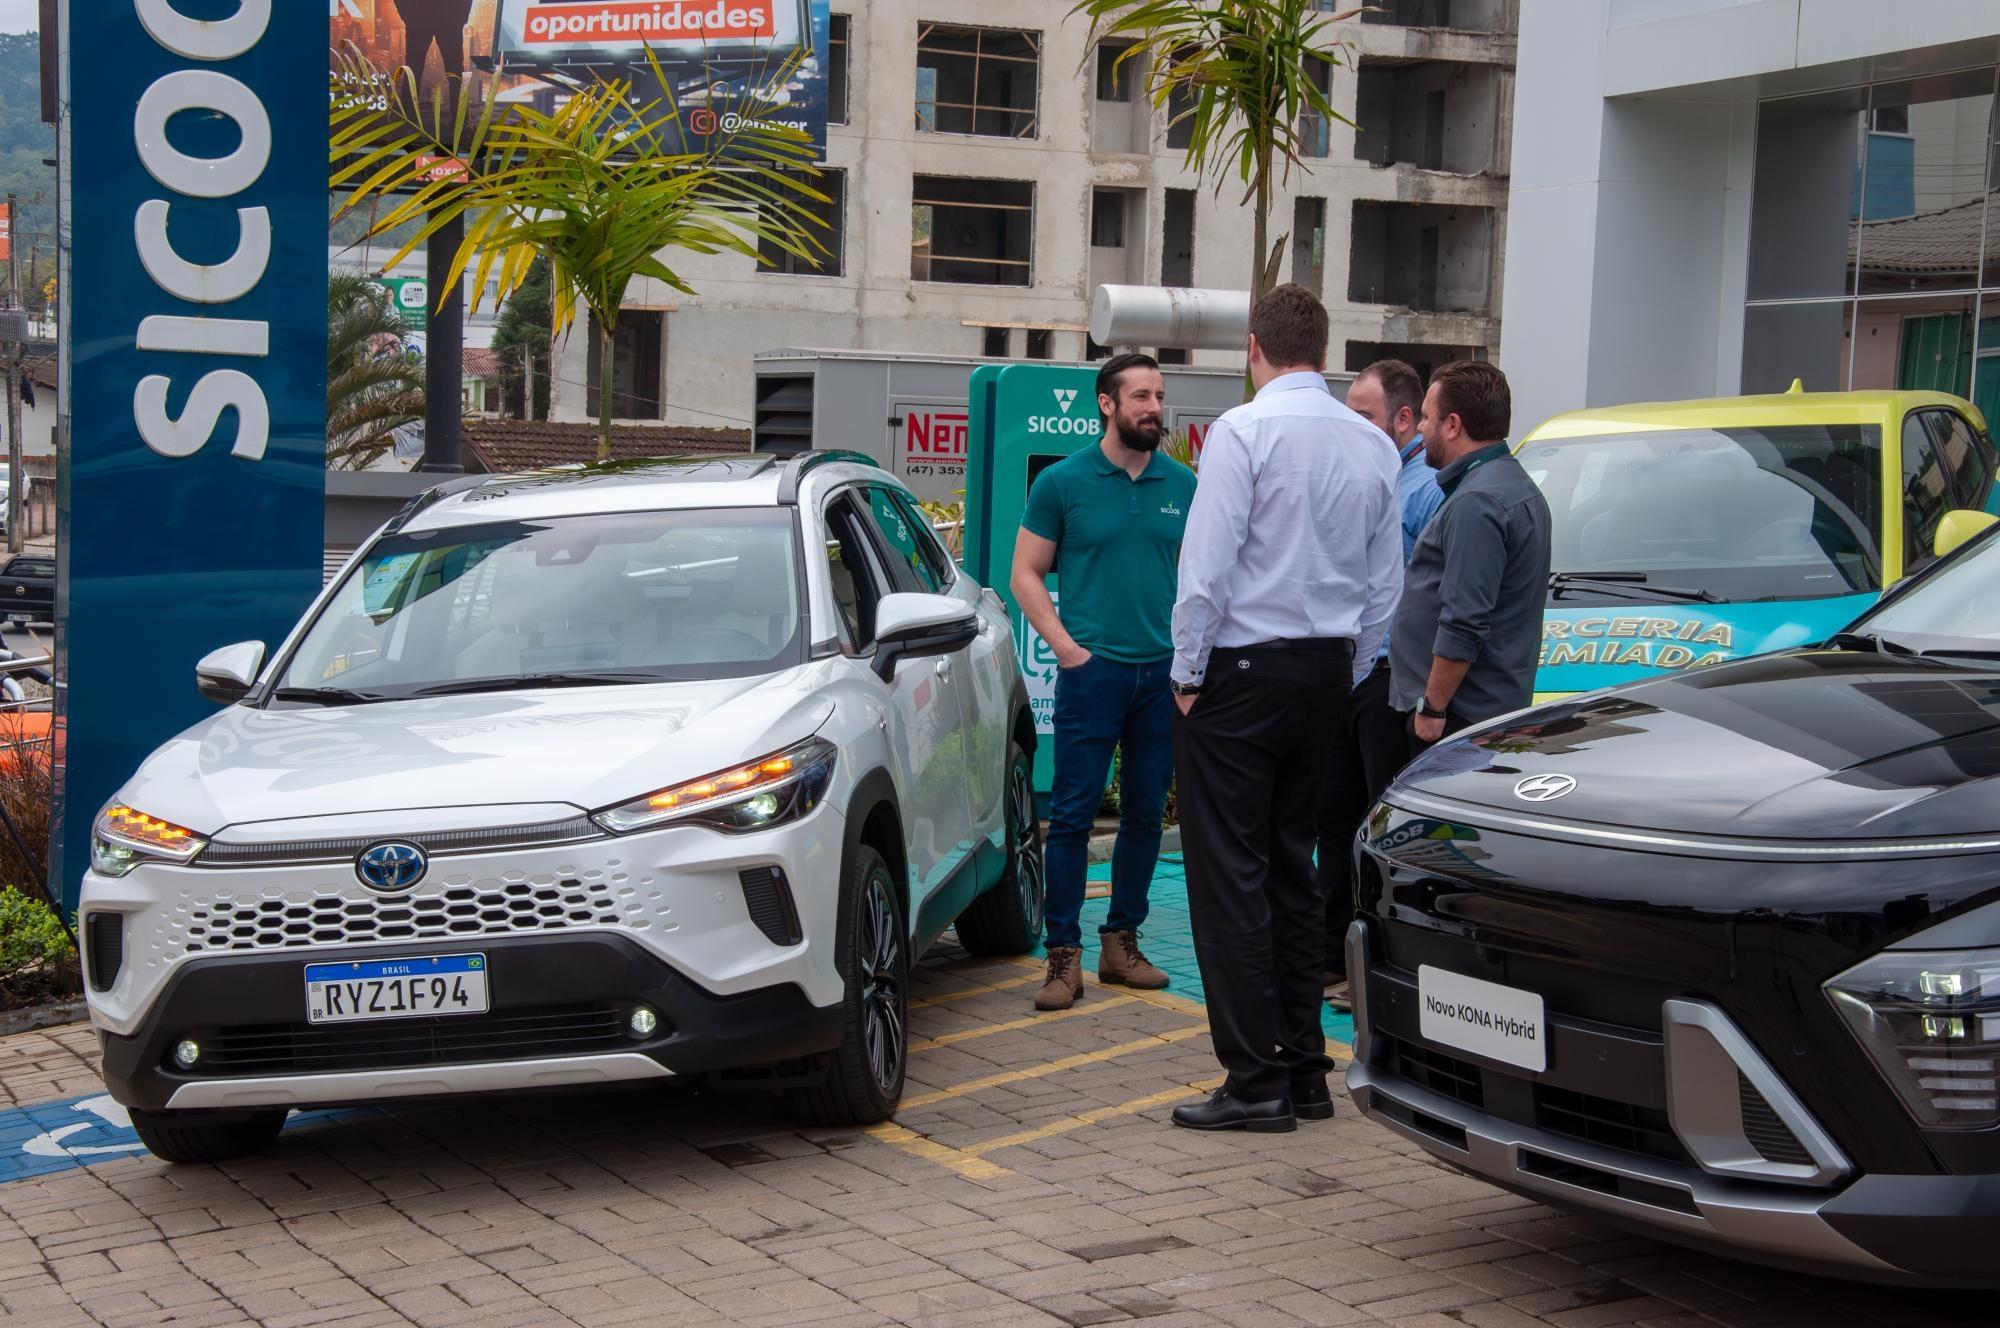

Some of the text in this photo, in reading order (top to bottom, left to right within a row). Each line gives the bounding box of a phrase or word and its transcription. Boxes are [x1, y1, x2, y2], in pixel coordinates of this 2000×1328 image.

[530, 5, 766, 40] oportunidades
[1027, 415, 1101, 435] SICOOB
[906, 465, 968, 476] (47) 353
[382, 965, 411, 975] BRASIL
[325, 976, 469, 1016] RYZ1F94
[313, 1008, 324, 1019] BR
[1426, 994, 1535, 1040] Novo KONA Hybrid
